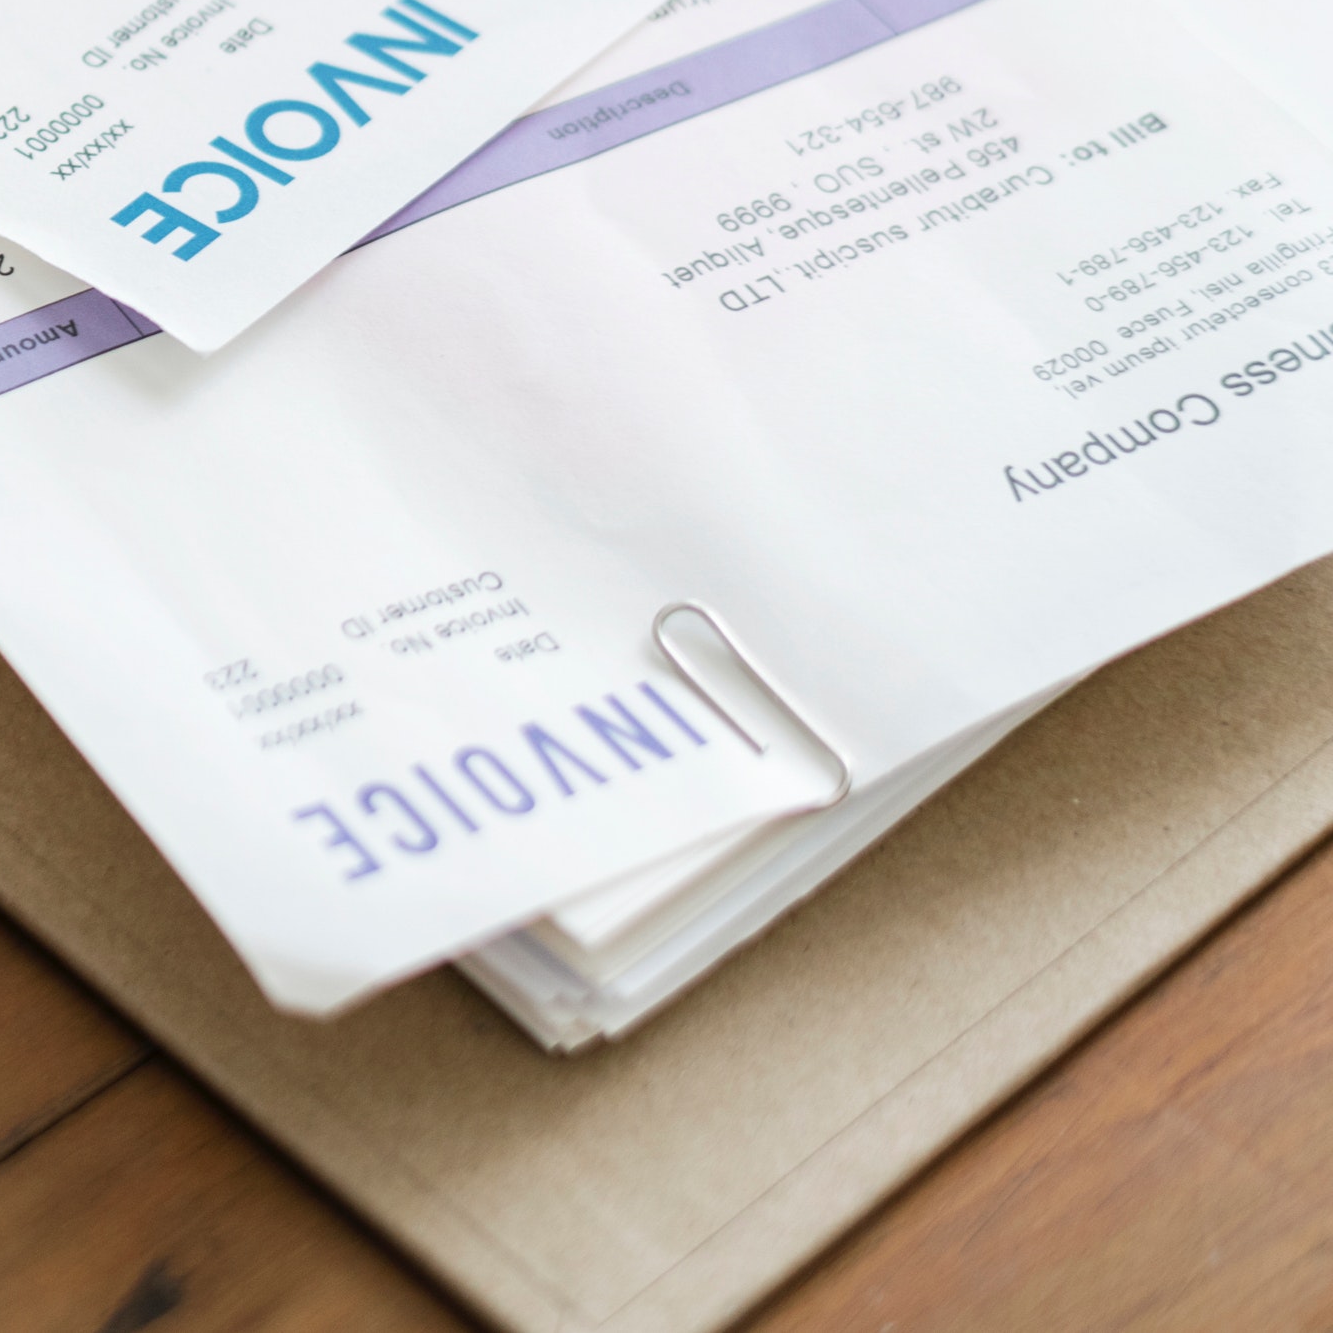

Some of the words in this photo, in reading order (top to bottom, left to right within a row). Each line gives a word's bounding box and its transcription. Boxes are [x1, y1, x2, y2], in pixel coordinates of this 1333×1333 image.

[220, 18, 273, 53] Date
[82, 47, 113, 68] ID
[120, 48, 167, 72] No.
[14, 95, 104, 160] 0000001
[547, 80, 691, 140] Description
[786, 76, 962, 156] 987-654-321
[947, 108, 998, 142] 2W
[1110, 113, 1167, 147] Bill
[51, 120, 133, 181] xx/xx/xx
[967, 137, 1018, 167] 456
[1061, 141, 1108, 166] to:
[814, 157, 884, 193] SUO
[1225, 173, 1282, 198] Fax.
[717, 193, 791, 232] 9999
[917, 166, 1054, 231] Curabitur
[662, 237, 764, 288] Aliquet
[1056, 203, 1223, 286] 123-456-789-1
[1085, 226, 1253, 312] 123-456-789-0
[1117, 300, 1193, 338] Fusce
[1181, 270, 1313, 340] consectetur
[1033, 340, 1108, 381] 00029
[1103, 337, 1177, 376] ipsum
[1221, 326, 1333, 396] ness
[1004, 394, 1220, 502] Company
[381, 571, 503, 624] Customer
[341, 616, 374, 639] ID
[434, 598, 529, 638] Invoice
[495, 632, 560, 661] Date
[292, 682, 708, 881] INVOICE
